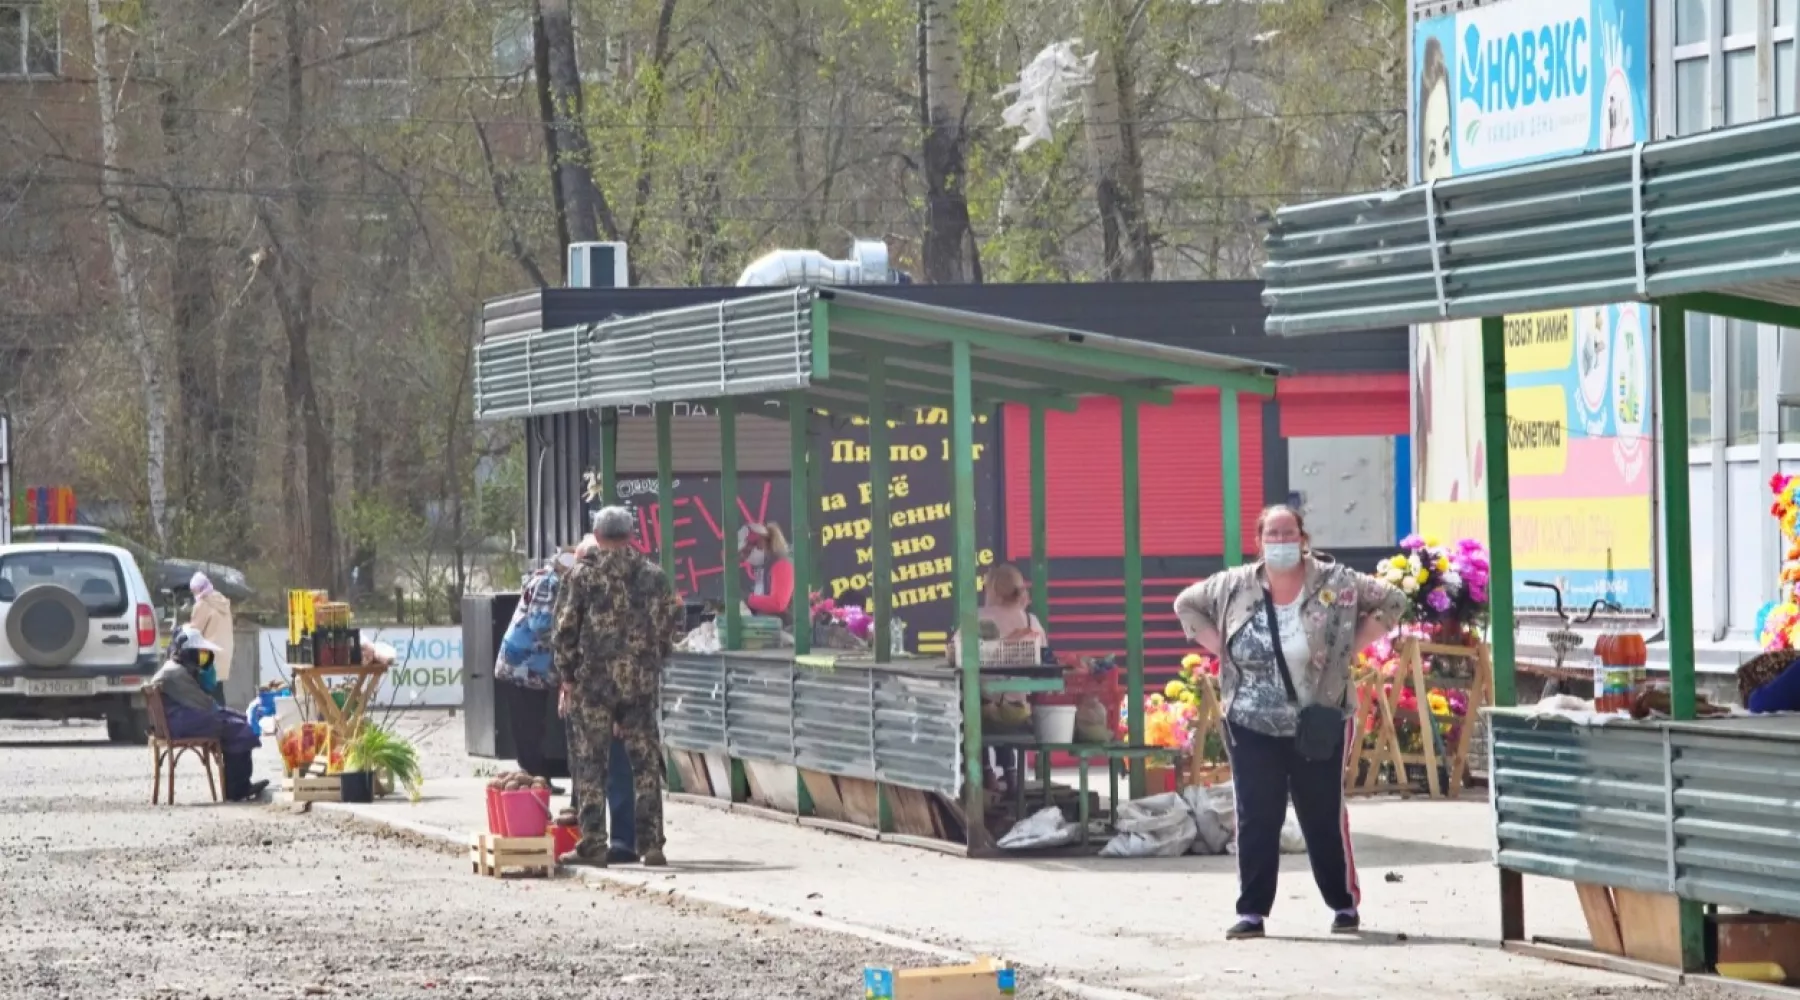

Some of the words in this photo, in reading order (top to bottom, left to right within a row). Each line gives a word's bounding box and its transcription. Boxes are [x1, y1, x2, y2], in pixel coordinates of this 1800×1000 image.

[1487, 16, 1588, 113] НОВЭКС
[888, 444, 928, 462] по
[856, 534, 936, 565] мню
